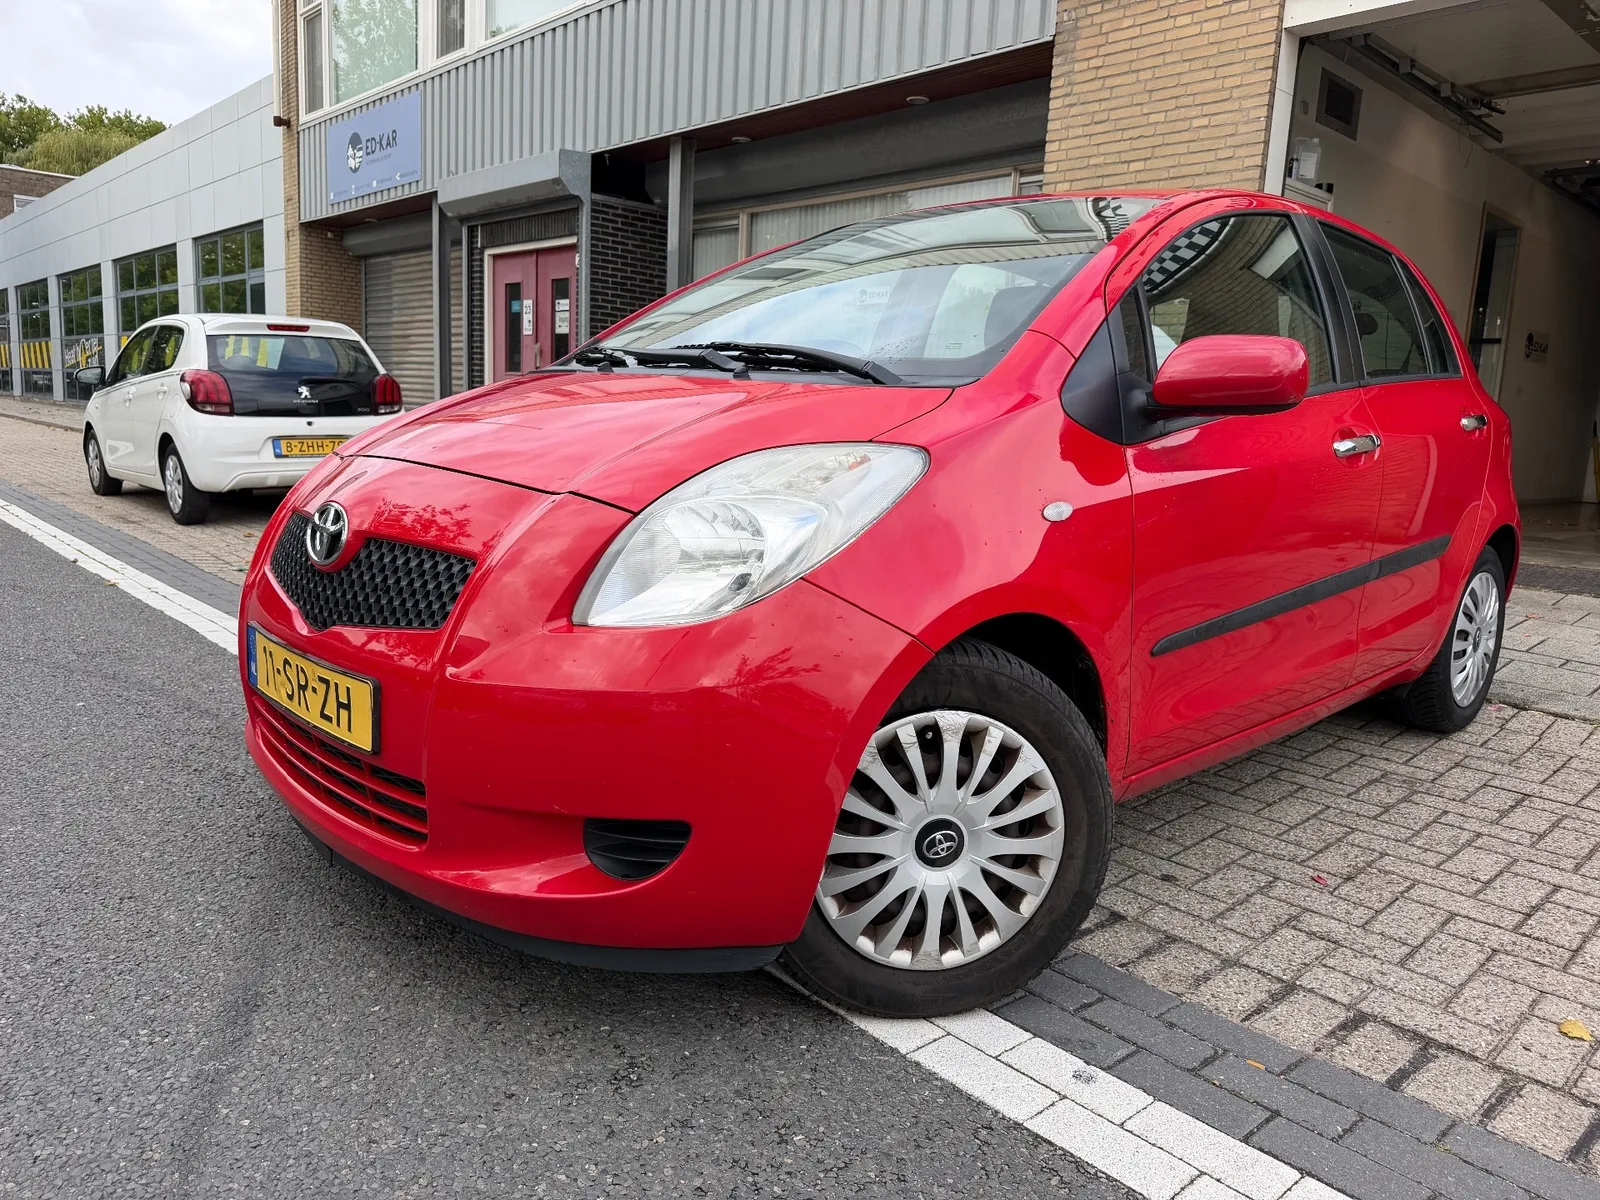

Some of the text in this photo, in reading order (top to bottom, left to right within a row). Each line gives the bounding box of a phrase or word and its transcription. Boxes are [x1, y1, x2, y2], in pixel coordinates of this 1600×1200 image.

[365, 128, 397, 157] ED-KAR
[525, 305, 531, 315] 23
[262, 645, 352, 734] 11-SR-ZH
